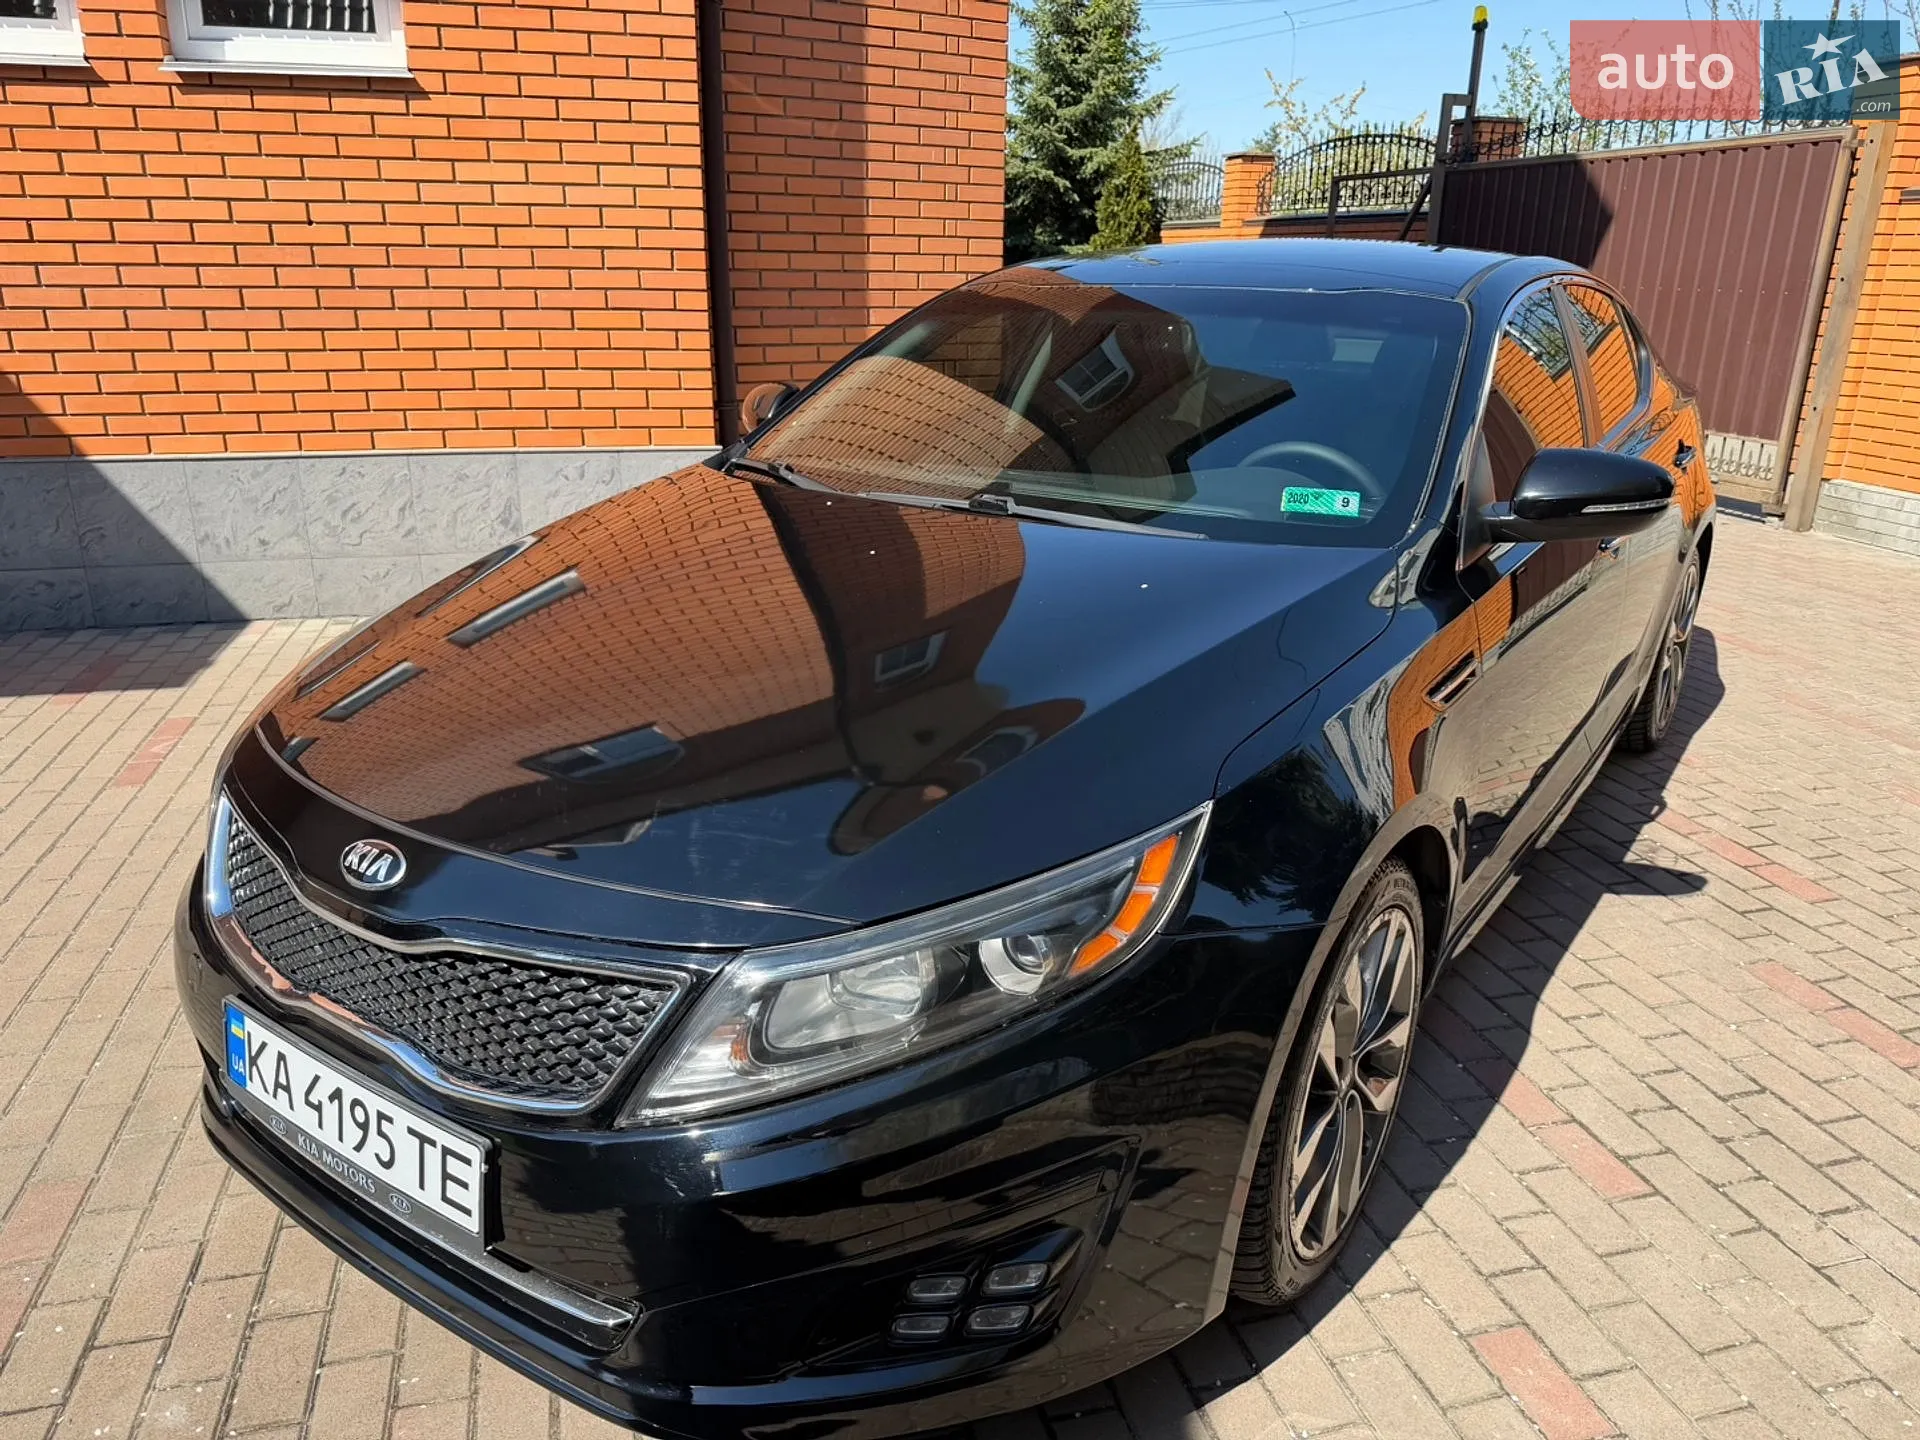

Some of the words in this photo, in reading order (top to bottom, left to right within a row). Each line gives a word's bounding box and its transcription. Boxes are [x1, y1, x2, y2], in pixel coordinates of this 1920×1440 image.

[1288, 493, 1309, 504] 2020
[1341, 497, 1350, 508] 9
[344, 842, 394, 881] KIA
[232, 1053, 245, 1074] UA
[247, 1031, 294, 1111] KA
[304, 1074, 395, 1170] 4195
[406, 1125, 472, 1218] TE
[298, 1133, 320, 1157] KIA
[321, 1148, 376, 1194] MOTORS
